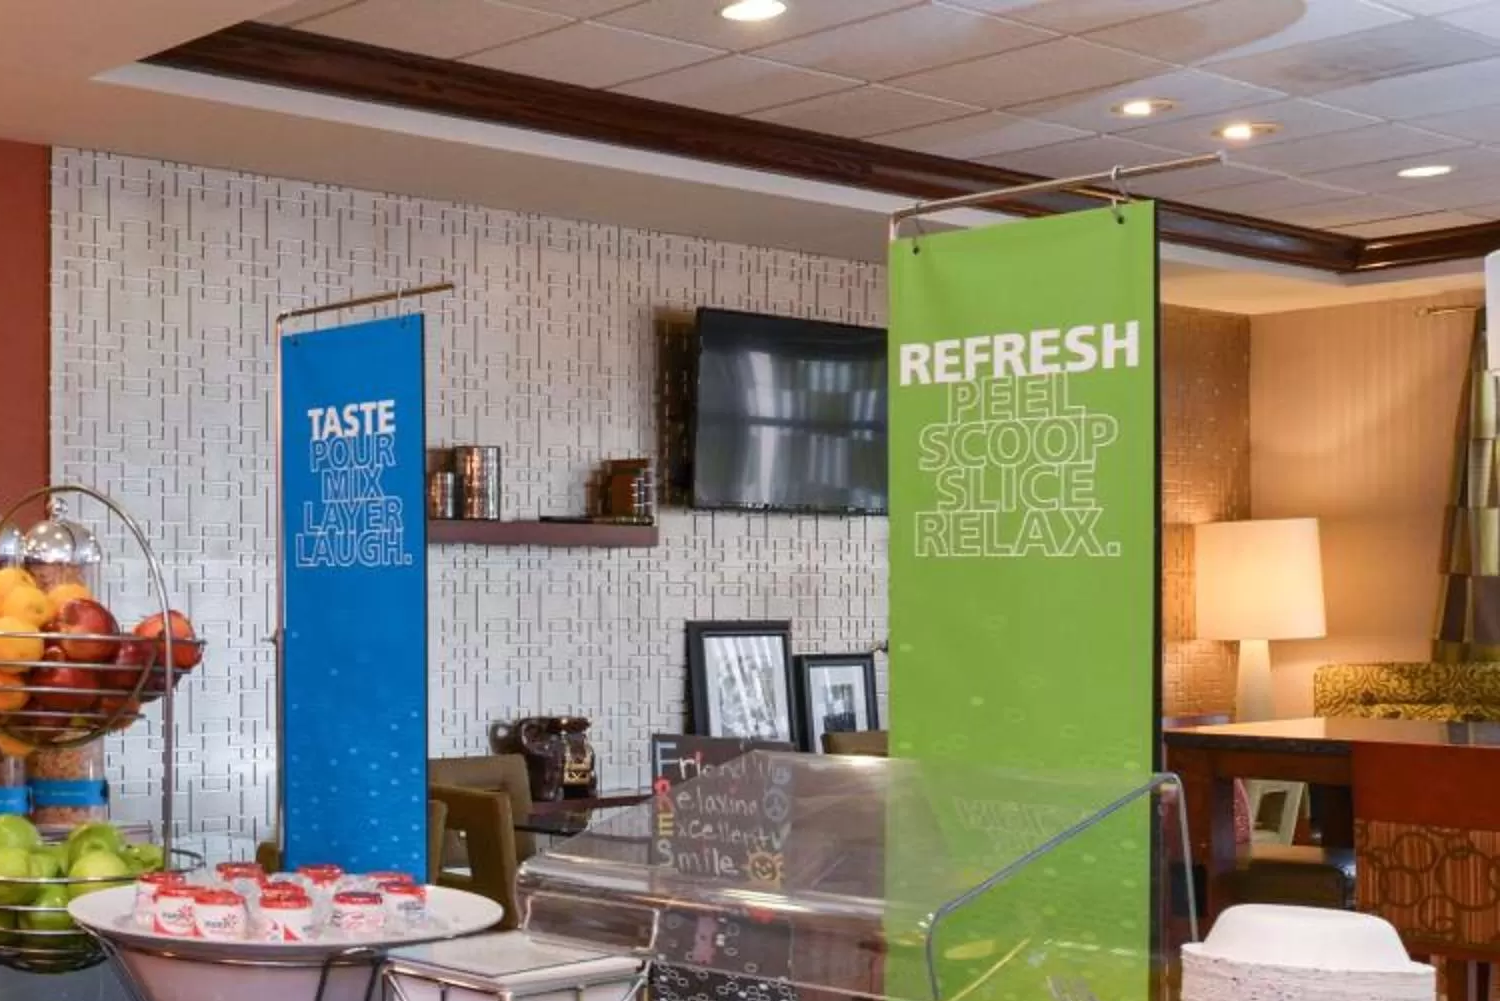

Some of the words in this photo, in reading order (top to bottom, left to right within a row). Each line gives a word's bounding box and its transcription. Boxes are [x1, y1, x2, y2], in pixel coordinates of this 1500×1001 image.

[899, 320, 1140, 387] REFRESH
[947, 370, 1086, 425] PEEL
[307, 399, 397, 441] TASTE
[309, 431, 397, 473] POUR
[918, 413, 1119, 471] SCOOP
[320, 465, 386, 502] MIX
[935, 462, 1097, 513] SLICE
[303, 495, 405, 535] LAYER
[914, 506, 1122, 558] RELAX.
[294, 531, 413, 568] LAUGH.
[656, 838, 740, 877] Smile
